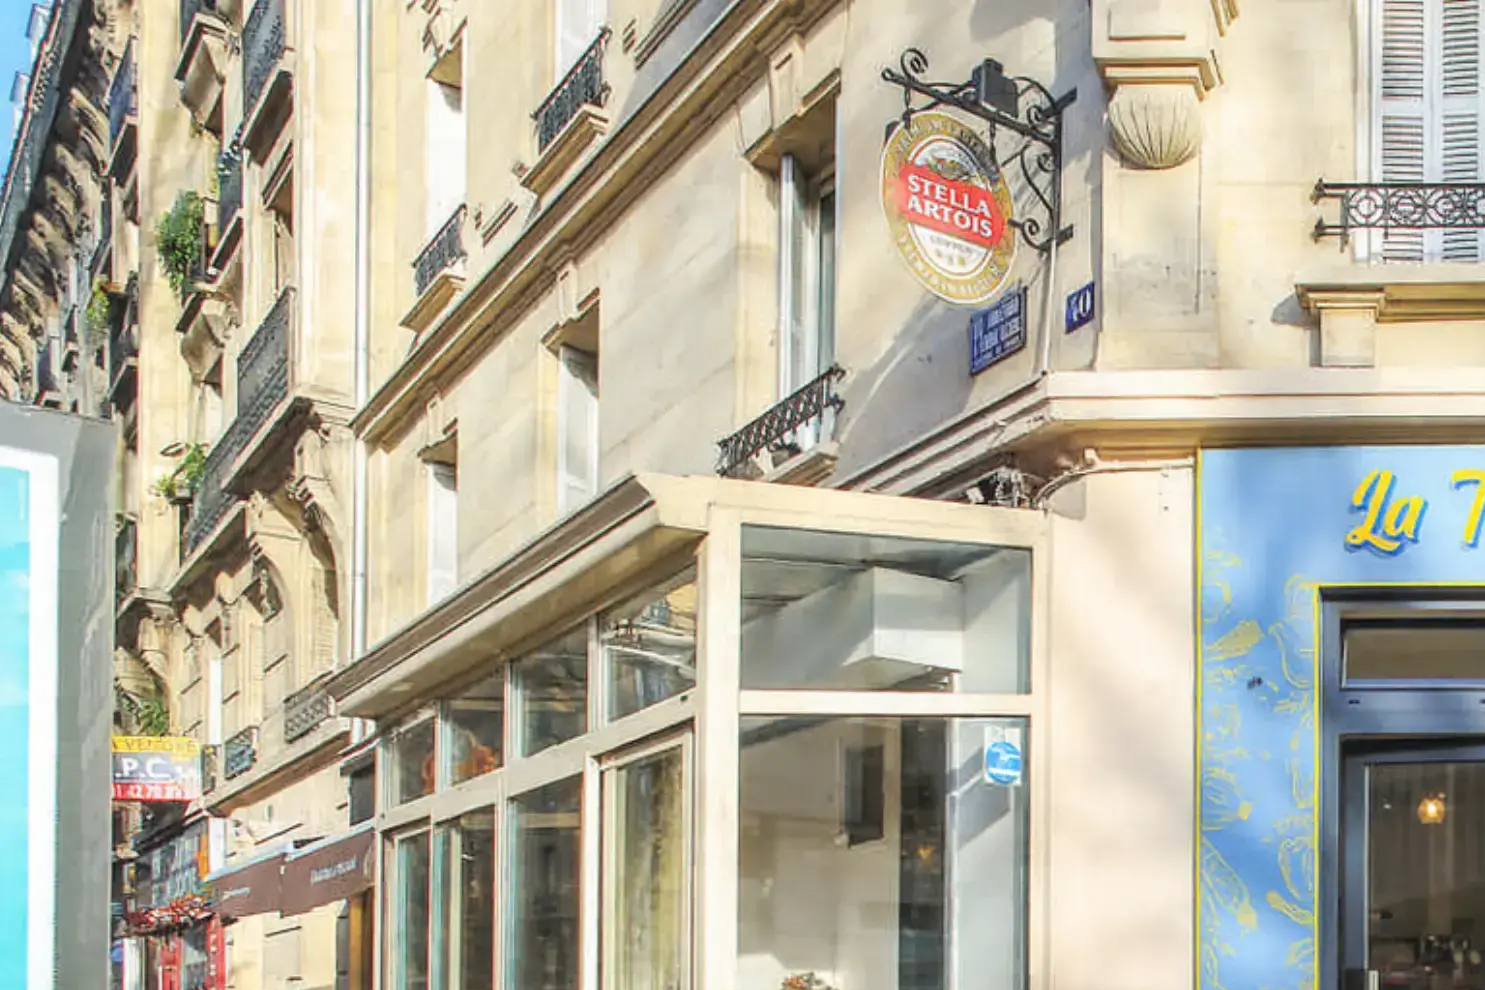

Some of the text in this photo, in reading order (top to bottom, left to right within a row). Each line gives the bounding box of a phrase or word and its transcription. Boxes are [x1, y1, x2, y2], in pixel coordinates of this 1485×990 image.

[907, 174, 992, 219] STELLA
[907, 195, 993, 239] ARTOIS
[1344, 468, 1429, 557] La
